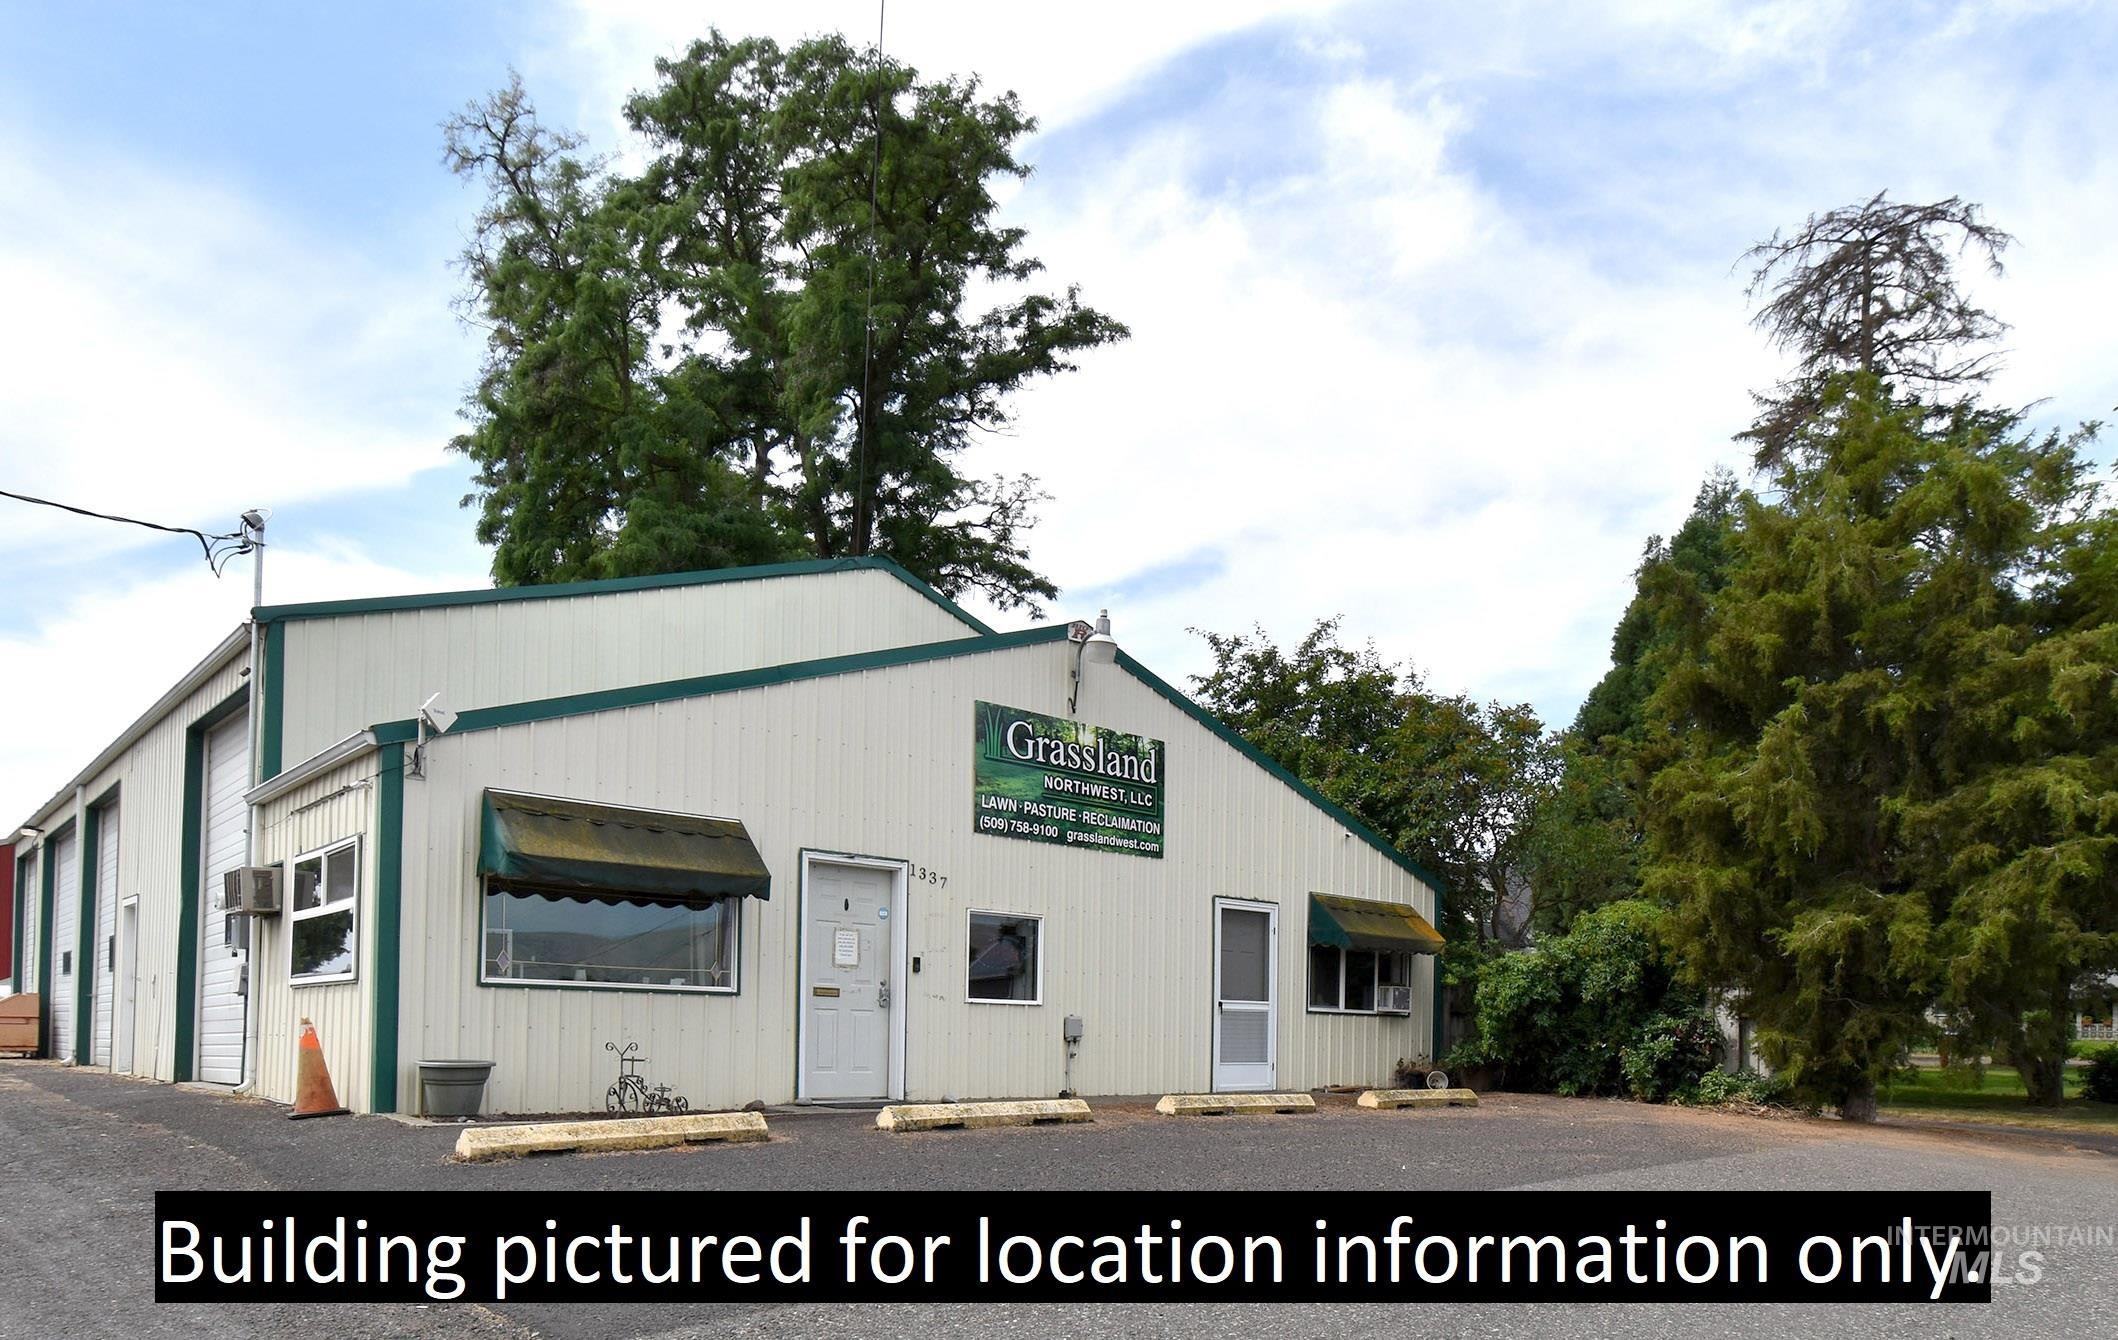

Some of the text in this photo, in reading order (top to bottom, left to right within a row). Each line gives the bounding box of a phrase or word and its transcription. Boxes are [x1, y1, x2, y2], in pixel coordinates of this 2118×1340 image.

[1006, 720, 1157, 784] Grassland
[1044, 775, 1153, 807] NORTHWEST, LLC
[981, 794, 1161, 835] LAWN PASTURE RECLAIMATION
[979, 815, 1160, 852] (509) 758-9100 grasslandwest.com
[909, 863, 948, 889] 1337
